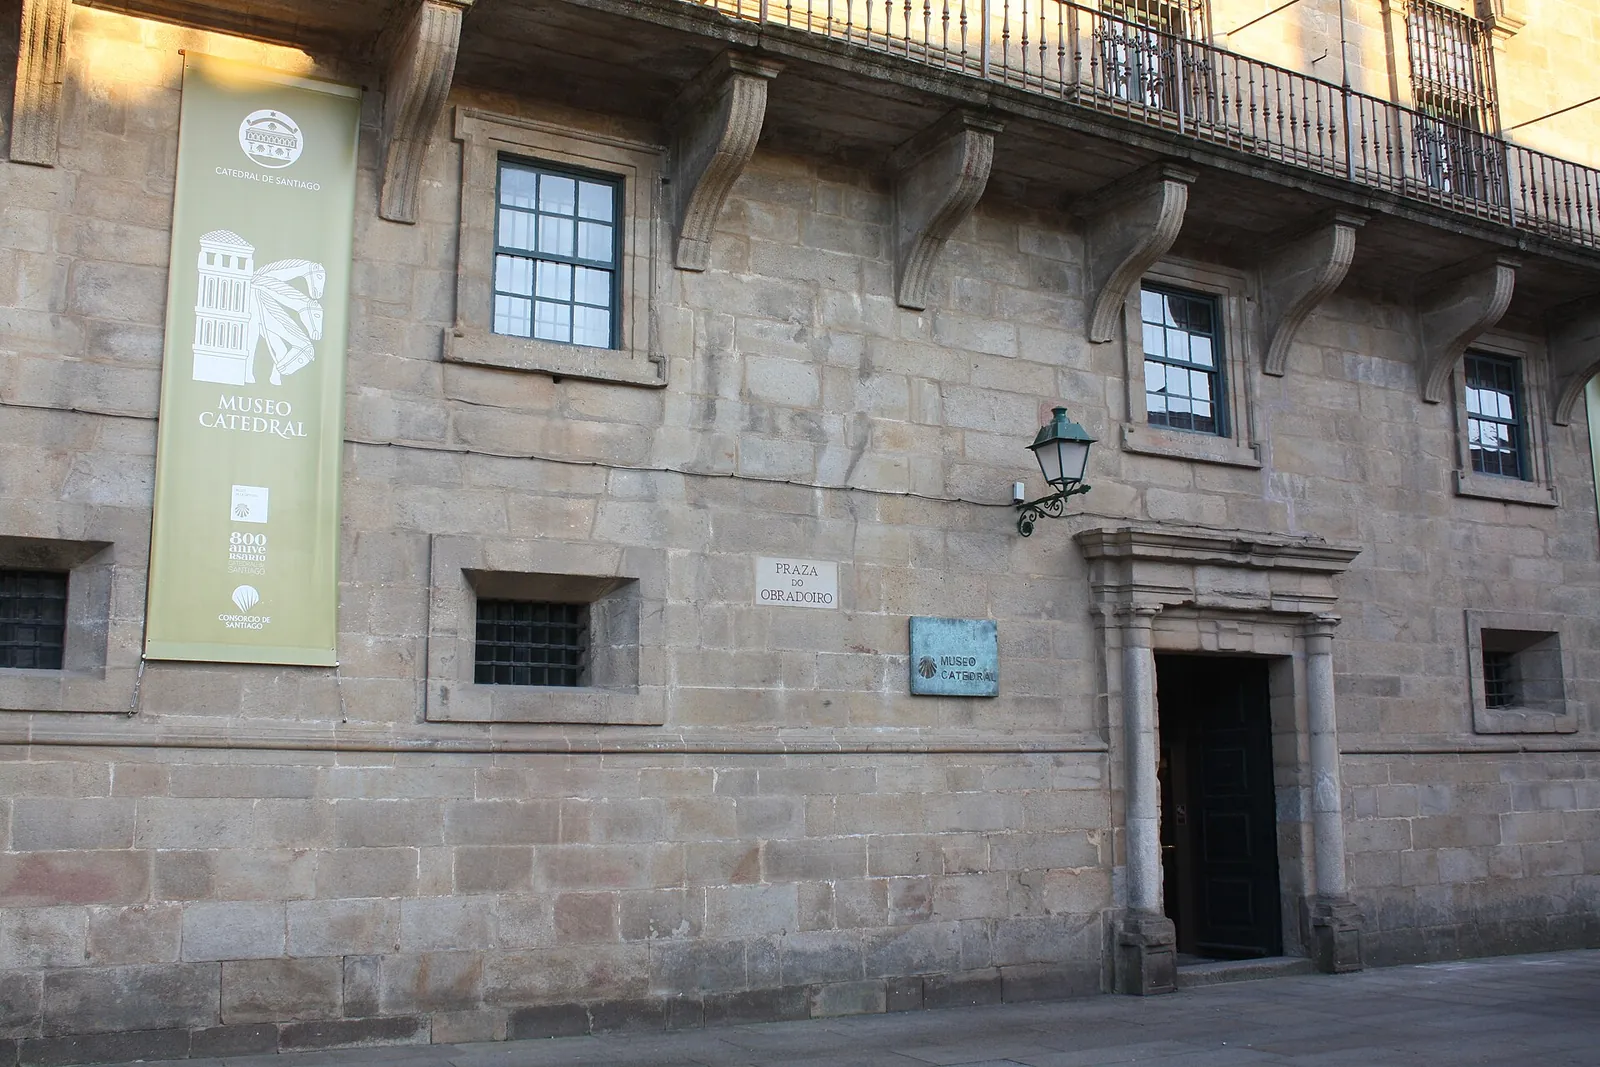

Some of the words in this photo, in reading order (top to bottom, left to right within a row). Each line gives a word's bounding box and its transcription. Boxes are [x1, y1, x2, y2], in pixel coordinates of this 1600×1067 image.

[215, 166, 260, 182] CATEDRAL
[261, 174, 274, 184] DE
[275, 177, 321, 191] SANTIAGO
[218, 394, 292, 416] MUSEO
[198, 411, 308, 440] CATEDRAL
[229, 531, 267, 546] 800
[775, 562, 818, 577] PRAZA
[791, 578, 804, 587] DO
[760, 588, 833, 604] OBRADOIRO
[218, 614, 261, 623] CONSORCIO
[225, 621, 263, 630] SANTIAGO
[940, 655, 977, 668] MUSEO
[940, 670, 997, 683] CATEDRAL
